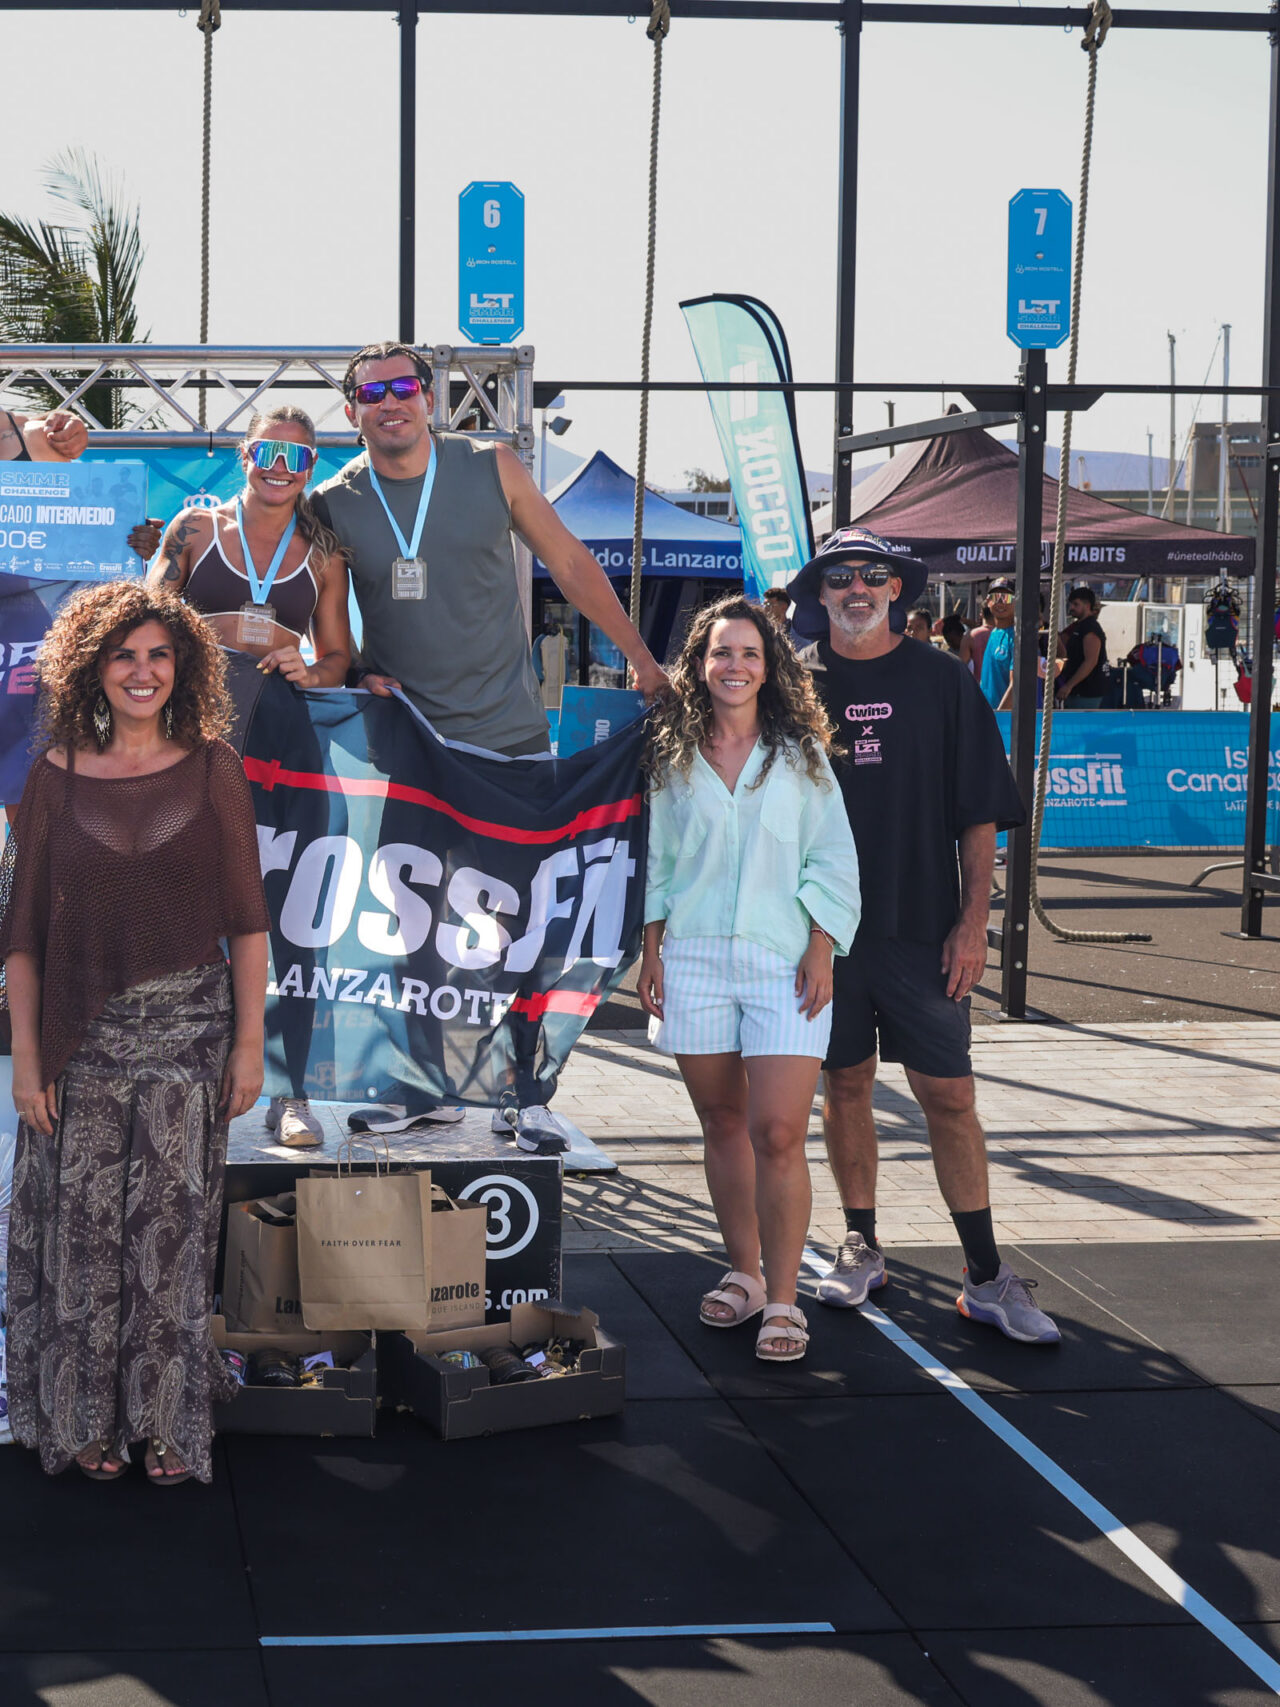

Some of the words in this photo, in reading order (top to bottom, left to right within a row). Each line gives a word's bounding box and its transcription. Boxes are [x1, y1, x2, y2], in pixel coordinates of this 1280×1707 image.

[483, 200, 501, 228] 6
[1034, 208, 1048, 236] 7
[1, 472, 70, 486] SMMR
[4, 488, 67, 496] CHALLENGE
[36, 505, 115, 525] INTERMEDIO
[651, 548, 743, 569] Lanzarot
[956, 546, 1016, 564] QUALIT
[1068, 546, 1126, 563] HABITS
[849, 706, 889, 717] twins
[855, 743, 881, 753] LZT
[1034, 762, 1126, 795] ossFit
[1044, 798, 1095, 807] NZAROTE
[257, 824, 636, 973] rossFit
[479, 1188, 512, 1243] 3
[378, 1239, 402, 1247] FEAR
[431, 1282, 480, 1302] zarote
